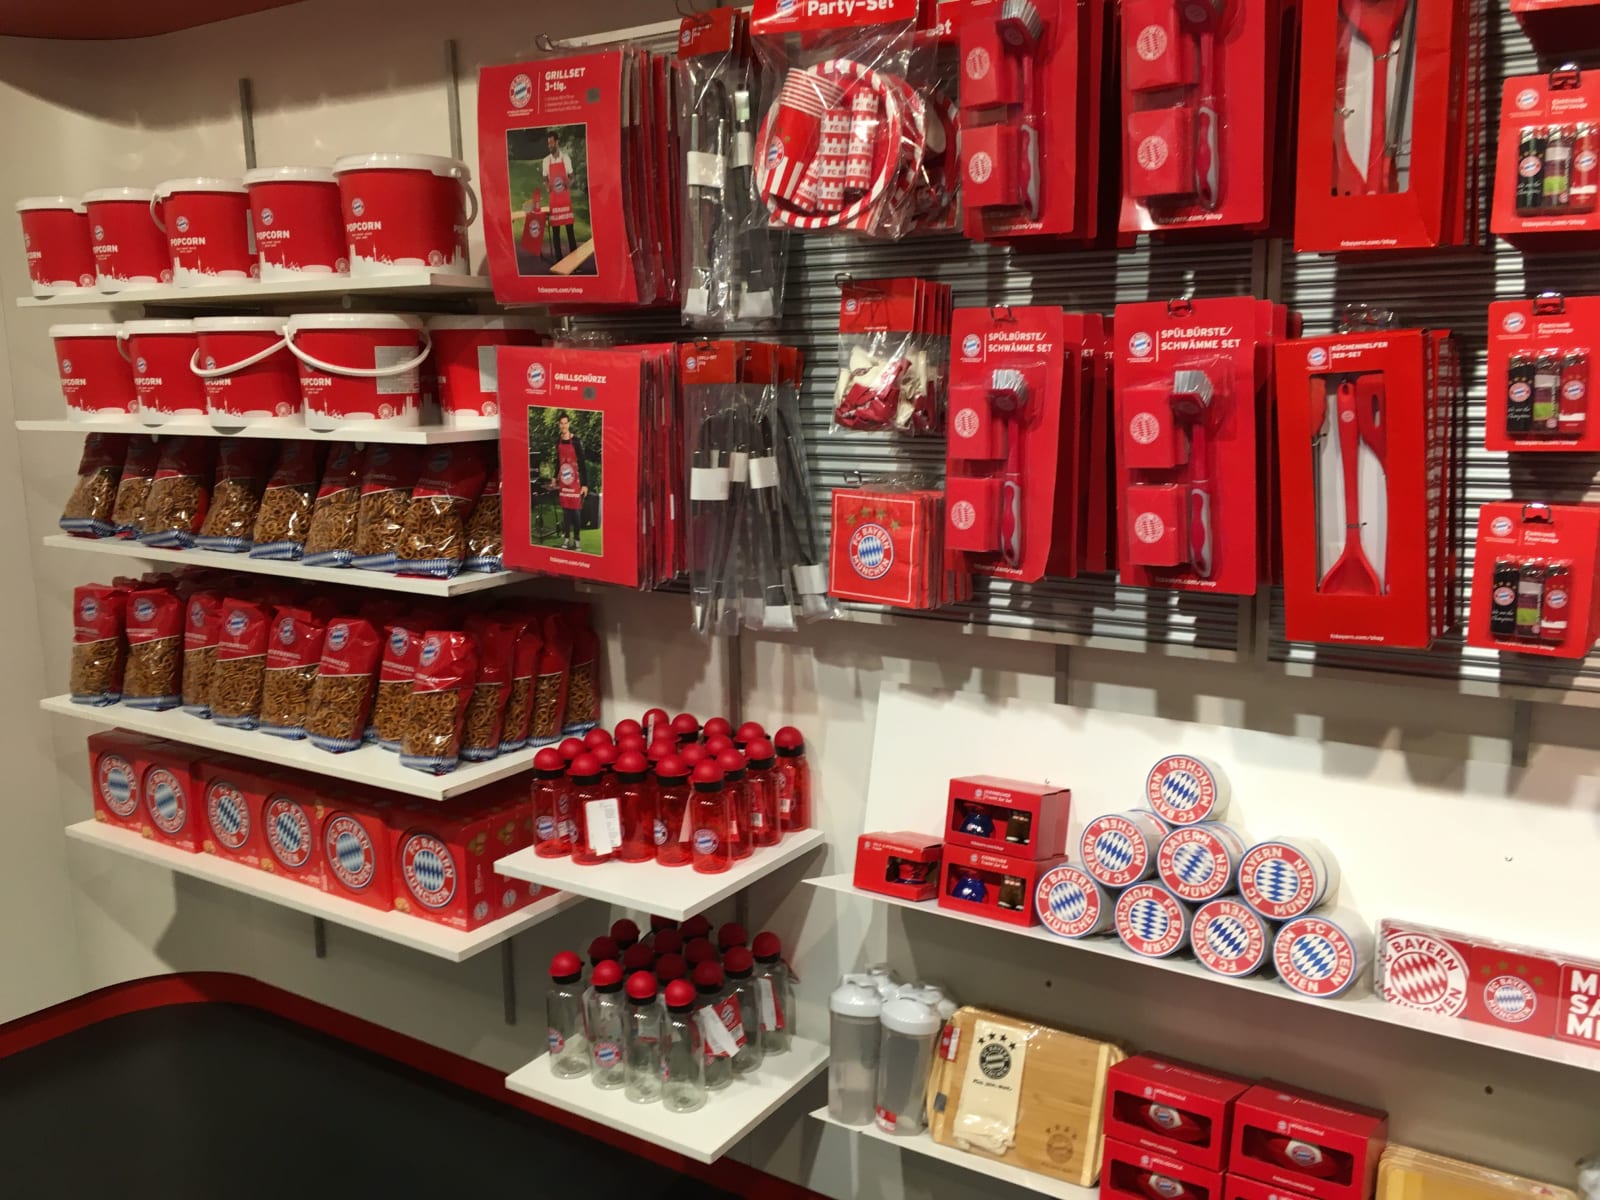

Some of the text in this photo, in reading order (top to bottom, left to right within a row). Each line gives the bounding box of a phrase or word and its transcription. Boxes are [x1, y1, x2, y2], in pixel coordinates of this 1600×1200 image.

[808, 0, 894, 16] Party-Set
[544, 68, 586, 80] GRILLSET
[170, 236, 206, 247] POPCORN
[988, 330, 1046, 342] SPÜLBÜRSTE/
[988, 343, 1052, 352] SCHWÄMME SET
[1161, 326, 1233, 339] SPÜLBÜRSTE/
[1161, 339, 1241, 351] SCHWÄMME SET
[554, 372, 607, 384] GRILLSCHÜRZE
[1151, 772, 1195, 821] FC BAYERN
[1169, 759, 1212, 807] MÜNCHEN
[421, 838, 453, 878] BAYERN
[1085, 834, 1130, 882] FC BAYERN
[1100, 819, 1143, 866] MÜNCHEN
[1161, 830, 1211, 876] FC BAYERN
[1040, 870, 1095, 899] FC BAYERN
[1178, 853, 1227, 896] MÜNCHEN
[1242, 848, 1283, 905] FC BAYERN
[1273, 858, 1313, 915] MÜNCHEN
[1043, 906, 1097, 933] MÜNCHEN
[1118, 888, 1153, 939] MÜNCHEN
[1142, 899, 1181, 952] FC BAYERN
[1220, 902, 1261, 962] MÜNCHEN
[1194, 912, 1237, 972] FC BAYERN
[1277, 930, 1319, 992] MÜNCHEN
[1304, 922, 1350, 986] FC BAYERN
[1392, 938, 1459, 972] BAYERN
